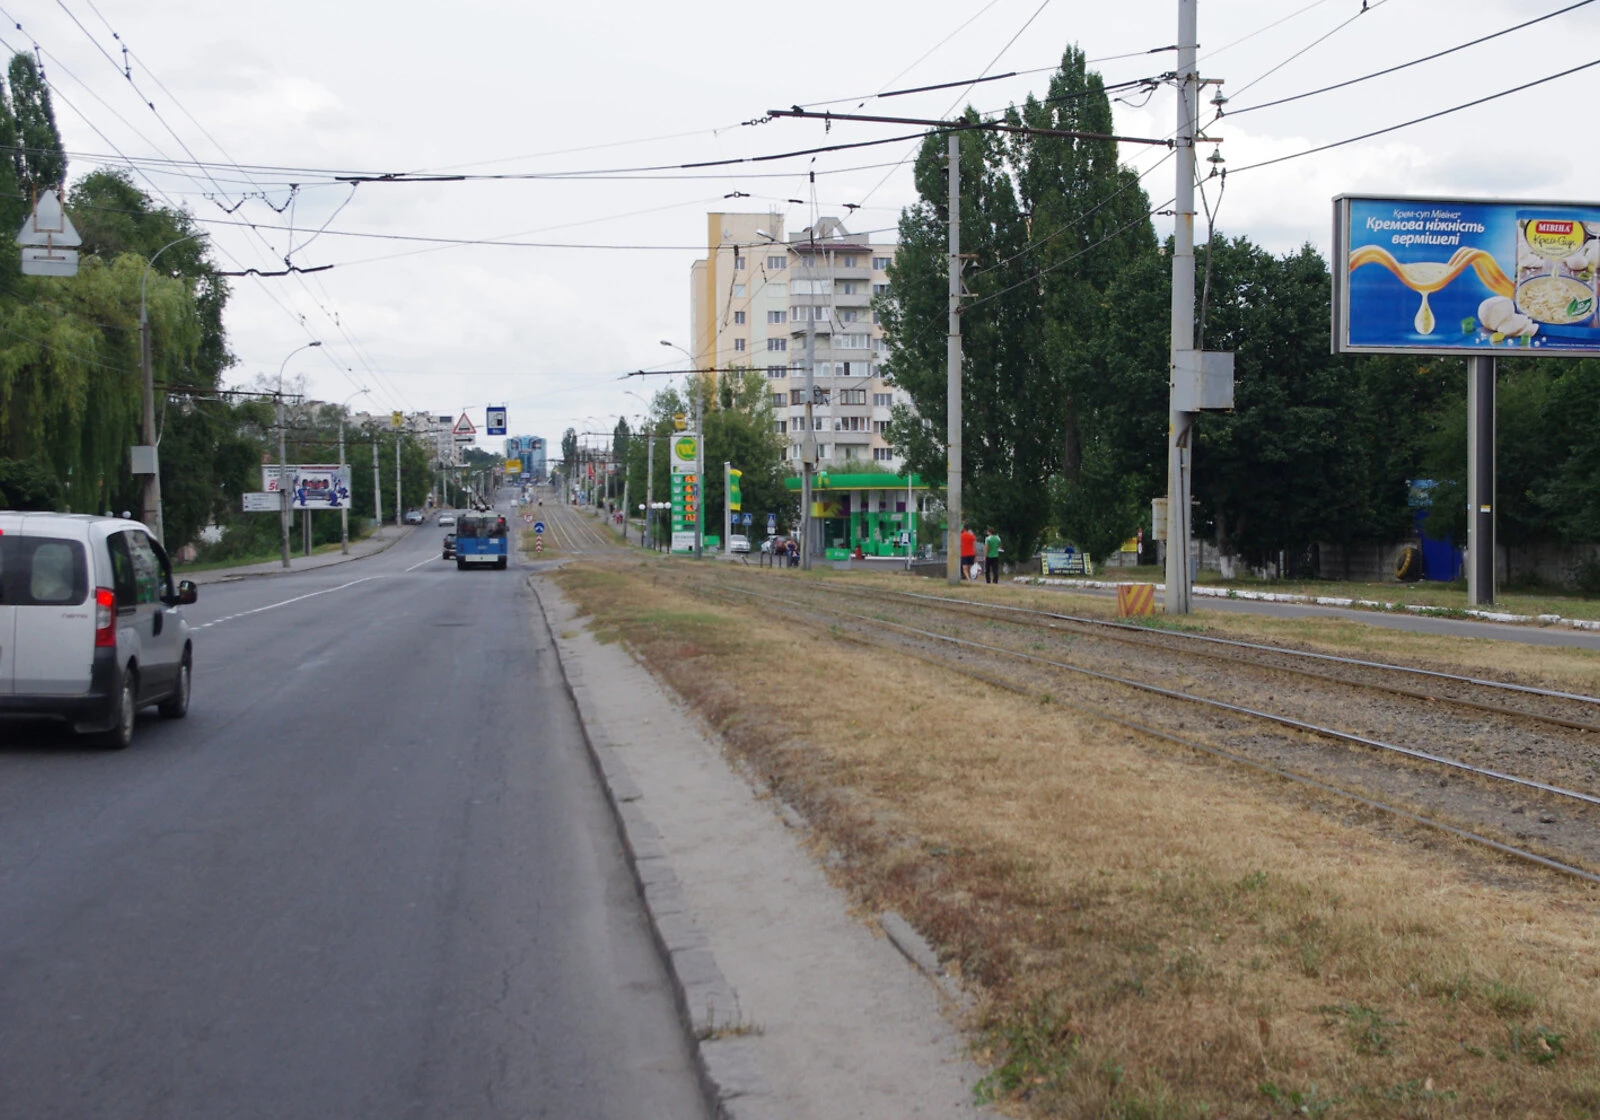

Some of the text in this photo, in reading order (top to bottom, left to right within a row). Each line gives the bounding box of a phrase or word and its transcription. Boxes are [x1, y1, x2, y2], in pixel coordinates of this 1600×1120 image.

[1393, 209, 1430, 221] Крем-суп
[1366, 217, 1485, 233] Кремова ніжність
[1391, 232, 1460, 247] вермішелі
